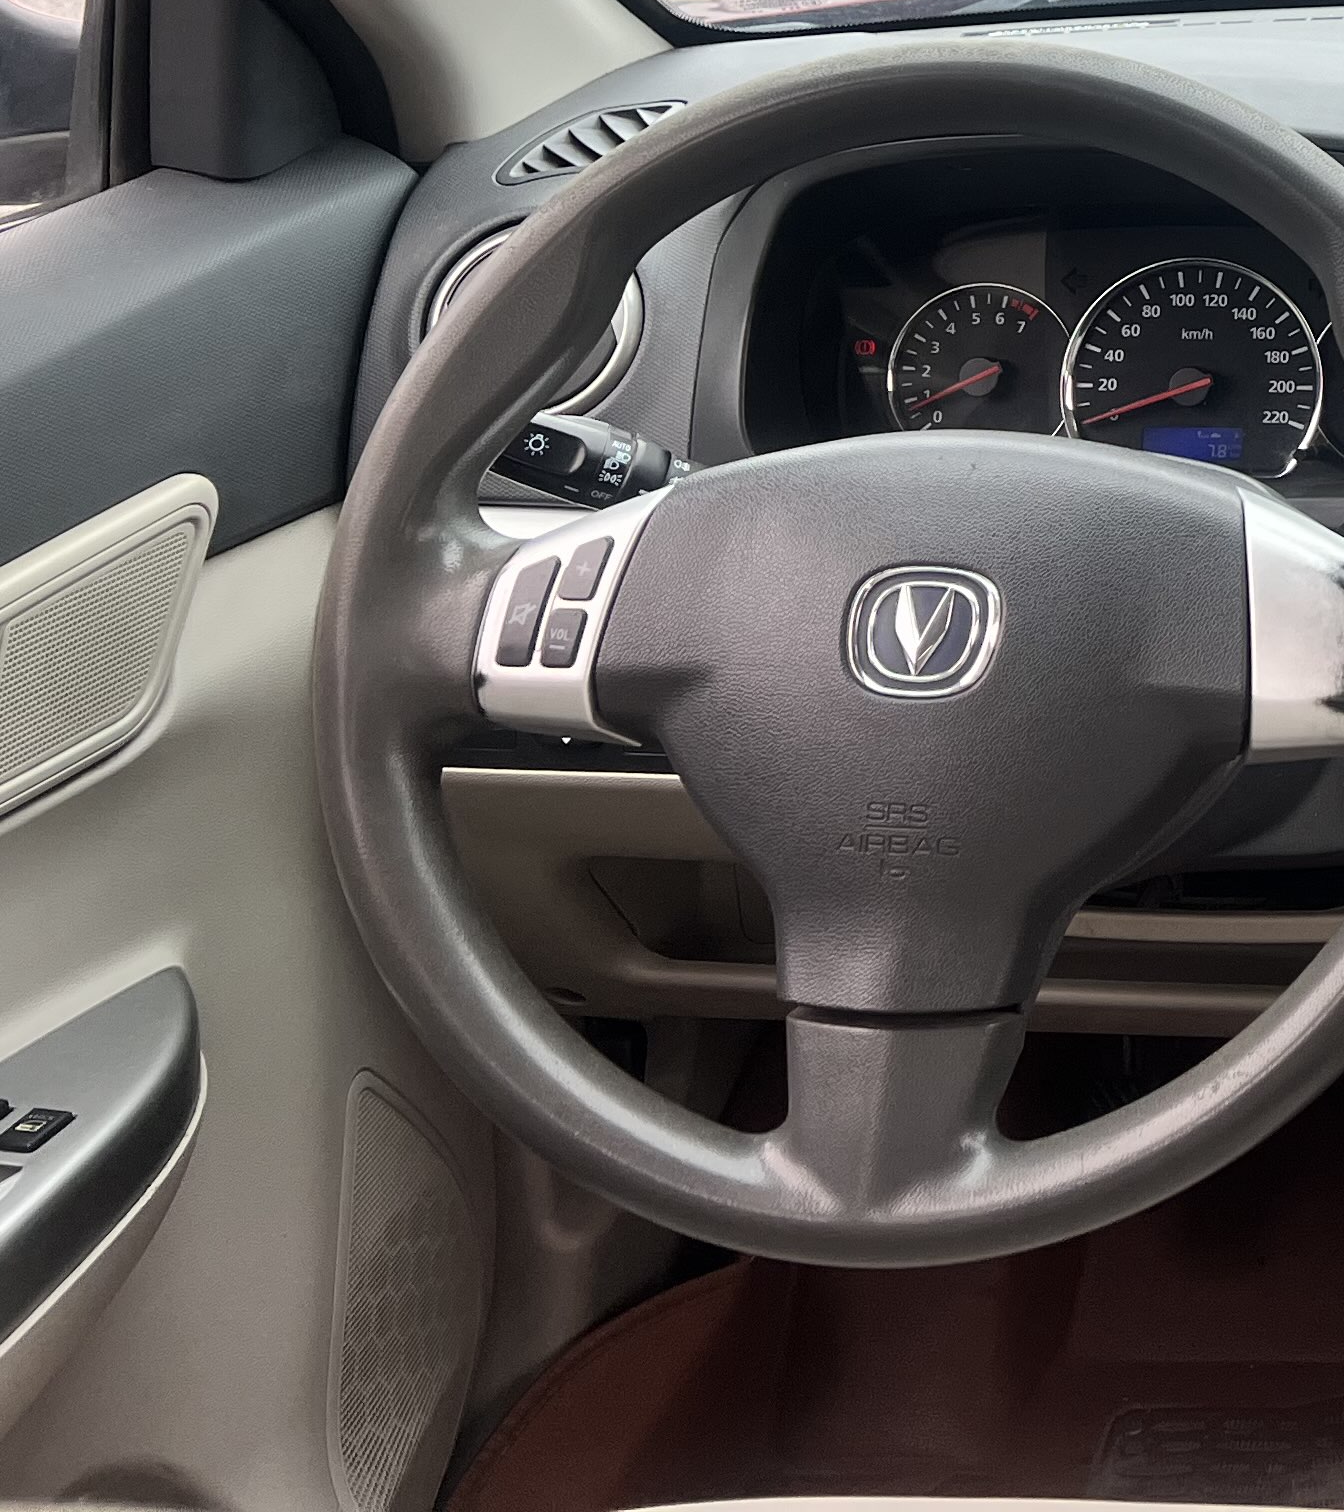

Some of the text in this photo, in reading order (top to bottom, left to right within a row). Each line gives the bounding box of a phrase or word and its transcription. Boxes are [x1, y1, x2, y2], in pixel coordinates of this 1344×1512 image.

[1170, 294, 1195, 307] 100
[1203, 294, 1228, 307] 120
[1141, 305, 1161, 318] 80
[1231, 307, 1257, 320] 140
[971, 312, 981, 325] 5
[995, 312, 1005, 325] 6
[945, 322, 957, 335] 4
[1016, 321, 1026, 334] 7
[1121, 324, 1141, 337] 60
[1249, 326, 1276, 339] 160
[1181, 328, 1214, 341] km/h
[930, 341, 940, 354] 3
[1104, 349, 1125, 363] 40
[1264, 351, 1290, 364] 180
[921, 365, 931, 378] 2
[1098, 378, 1118, 392] 20
[1268, 380, 1296, 393] 200
[932, 410, 943, 423] 0
[1262, 410, 1289, 424] 220
[611, 439, 632, 452] AUTO
[590, 489, 614, 501] OFF
[550, 628, 571, 642] VOL
[865, 801, 929, 823] SRS
